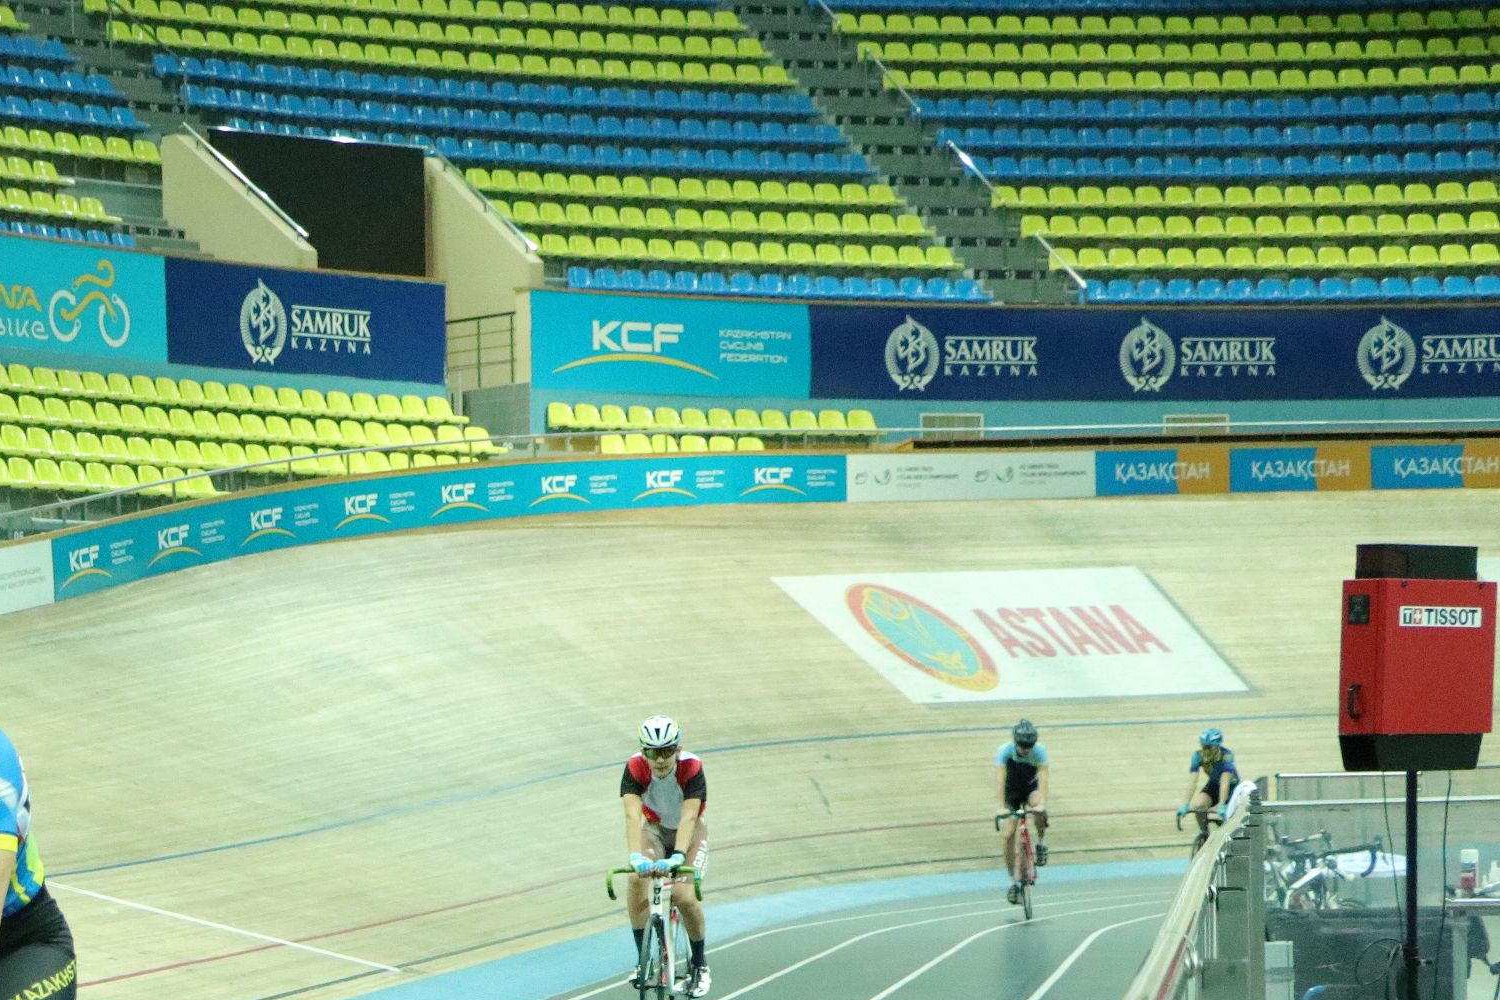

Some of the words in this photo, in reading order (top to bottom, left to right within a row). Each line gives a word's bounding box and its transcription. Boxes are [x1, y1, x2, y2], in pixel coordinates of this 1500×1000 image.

[291, 309, 371, 339] SAMRUK
[291, 338, 372, 355] KAZYNA
[592, 320, 684, 353] KCF
[944, 339, 1038, 362] SAMRUK
[1180, 340, 1276, 362] SAMRUK
[944, 364, 1038, 377] KAZYNA
[1180, 364, 1276, 376] KAZYNA
[541, 474, 577, 494] KCF
[646, 470, 683, 488] KCF
[754, 467, 793, 484] KCF
[442, 482, 476, 503] KCF
[344, 494, 378, 515] KCF
[251, 507, 282, 530] KCF
[158, 525, 189, 550] KCF
[69, 545, 99, 573] KCF
[1425, 608, 1478, 626] TISSOT
[972, 604, 1172, 659] ASTANA
